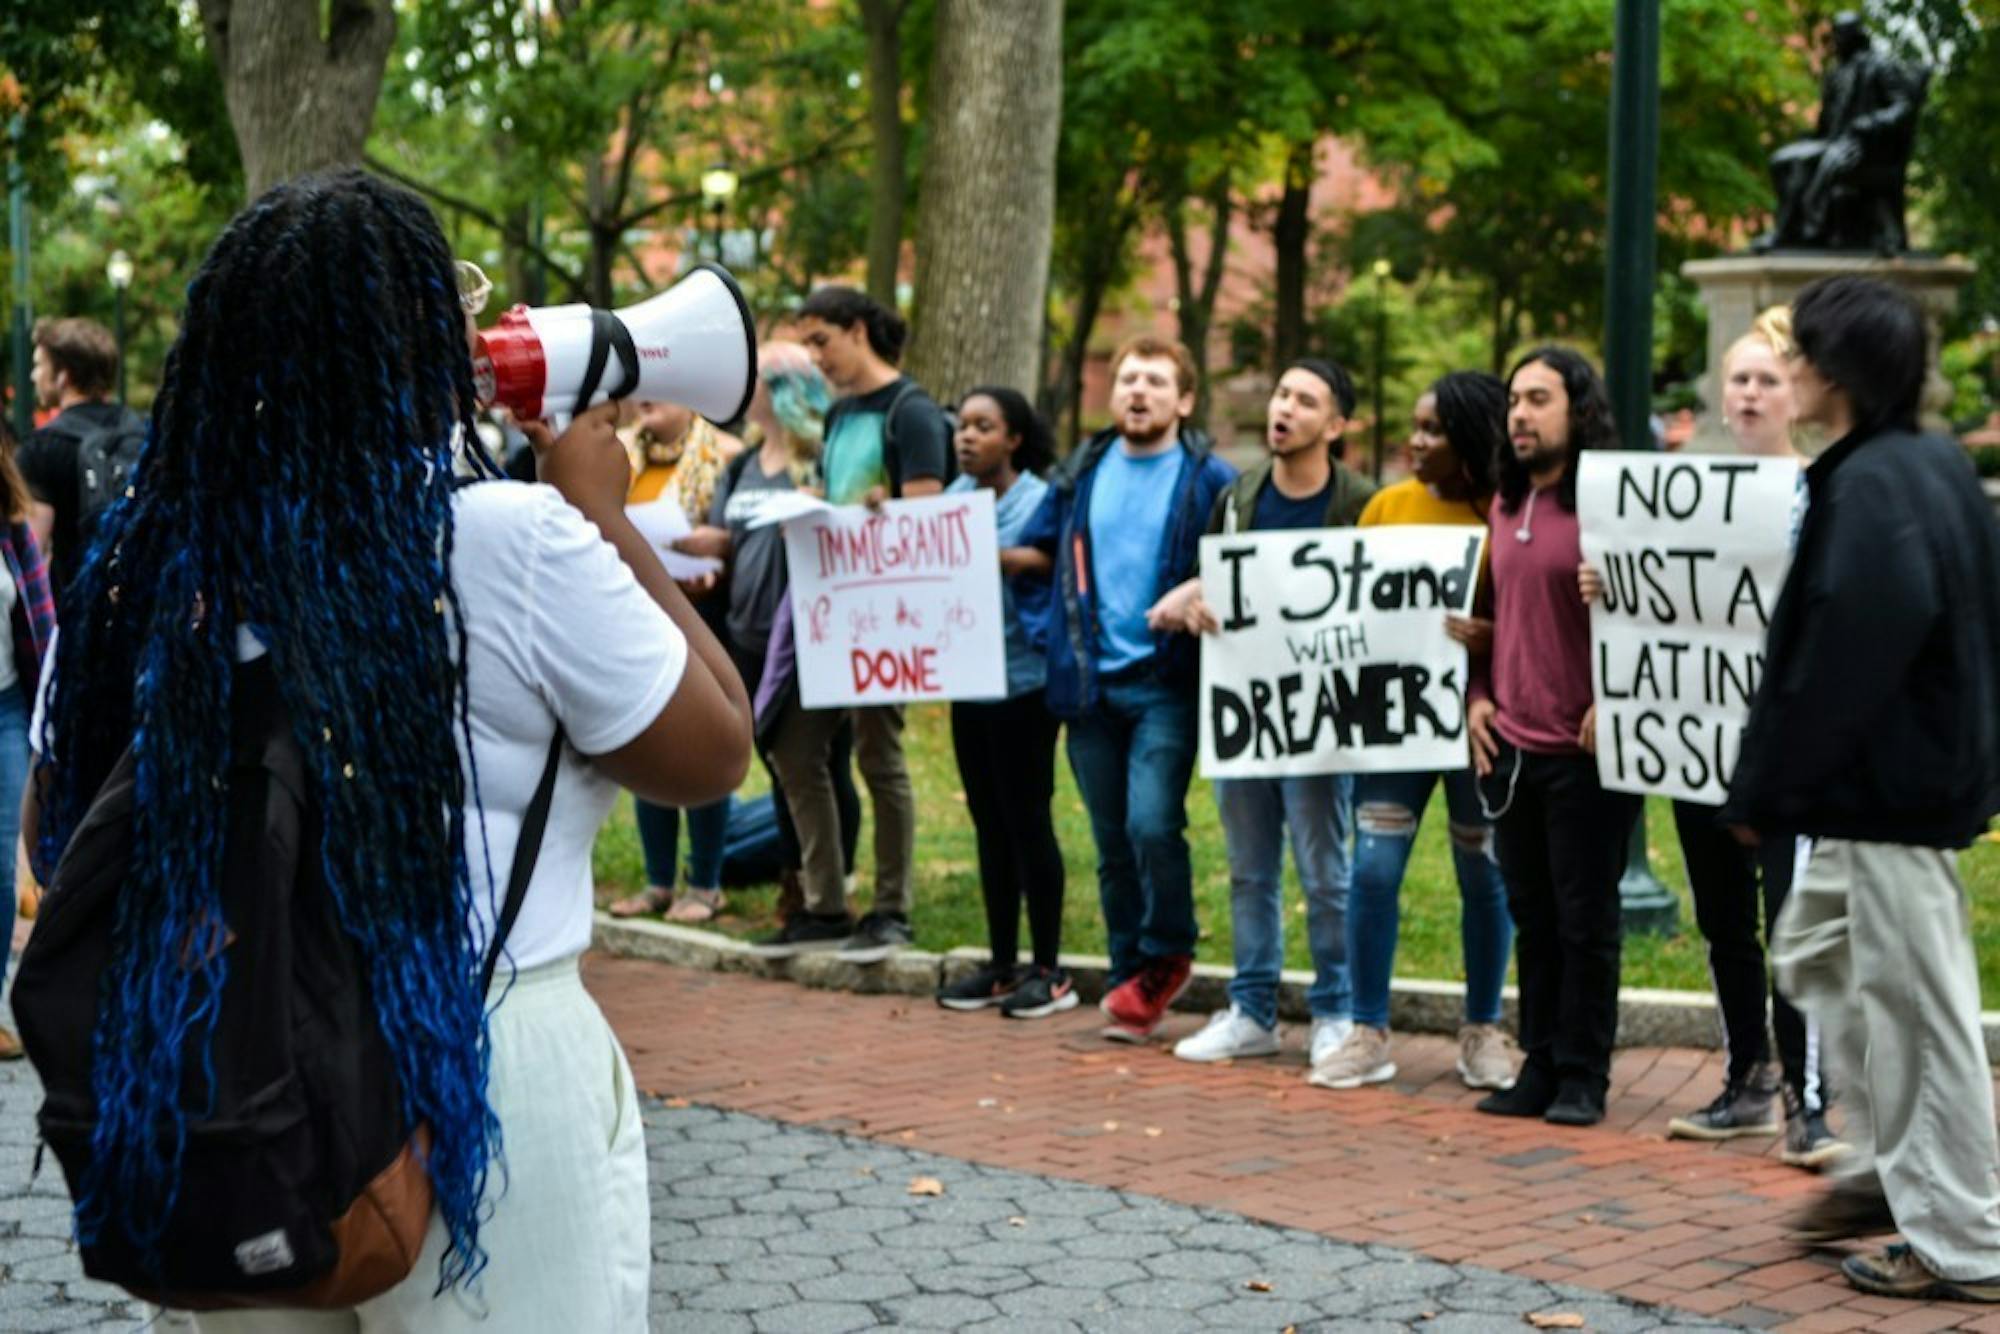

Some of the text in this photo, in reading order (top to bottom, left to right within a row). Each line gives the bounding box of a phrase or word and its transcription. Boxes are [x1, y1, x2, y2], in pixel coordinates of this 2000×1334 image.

[1617, 463, 1759, 524] NOT
[813, 506, 972, 578] IMMIGRANTS
[1220, 536, 1480, 631] I Stand
[1602, 550, 1769, 627] JUST A
[848, 600, 881, 643] get
[1286, 622, 1369, 665] WITH
[851, 645, 941, 693] DONE
[1210, 662, 1464, 763] DREAMERS
